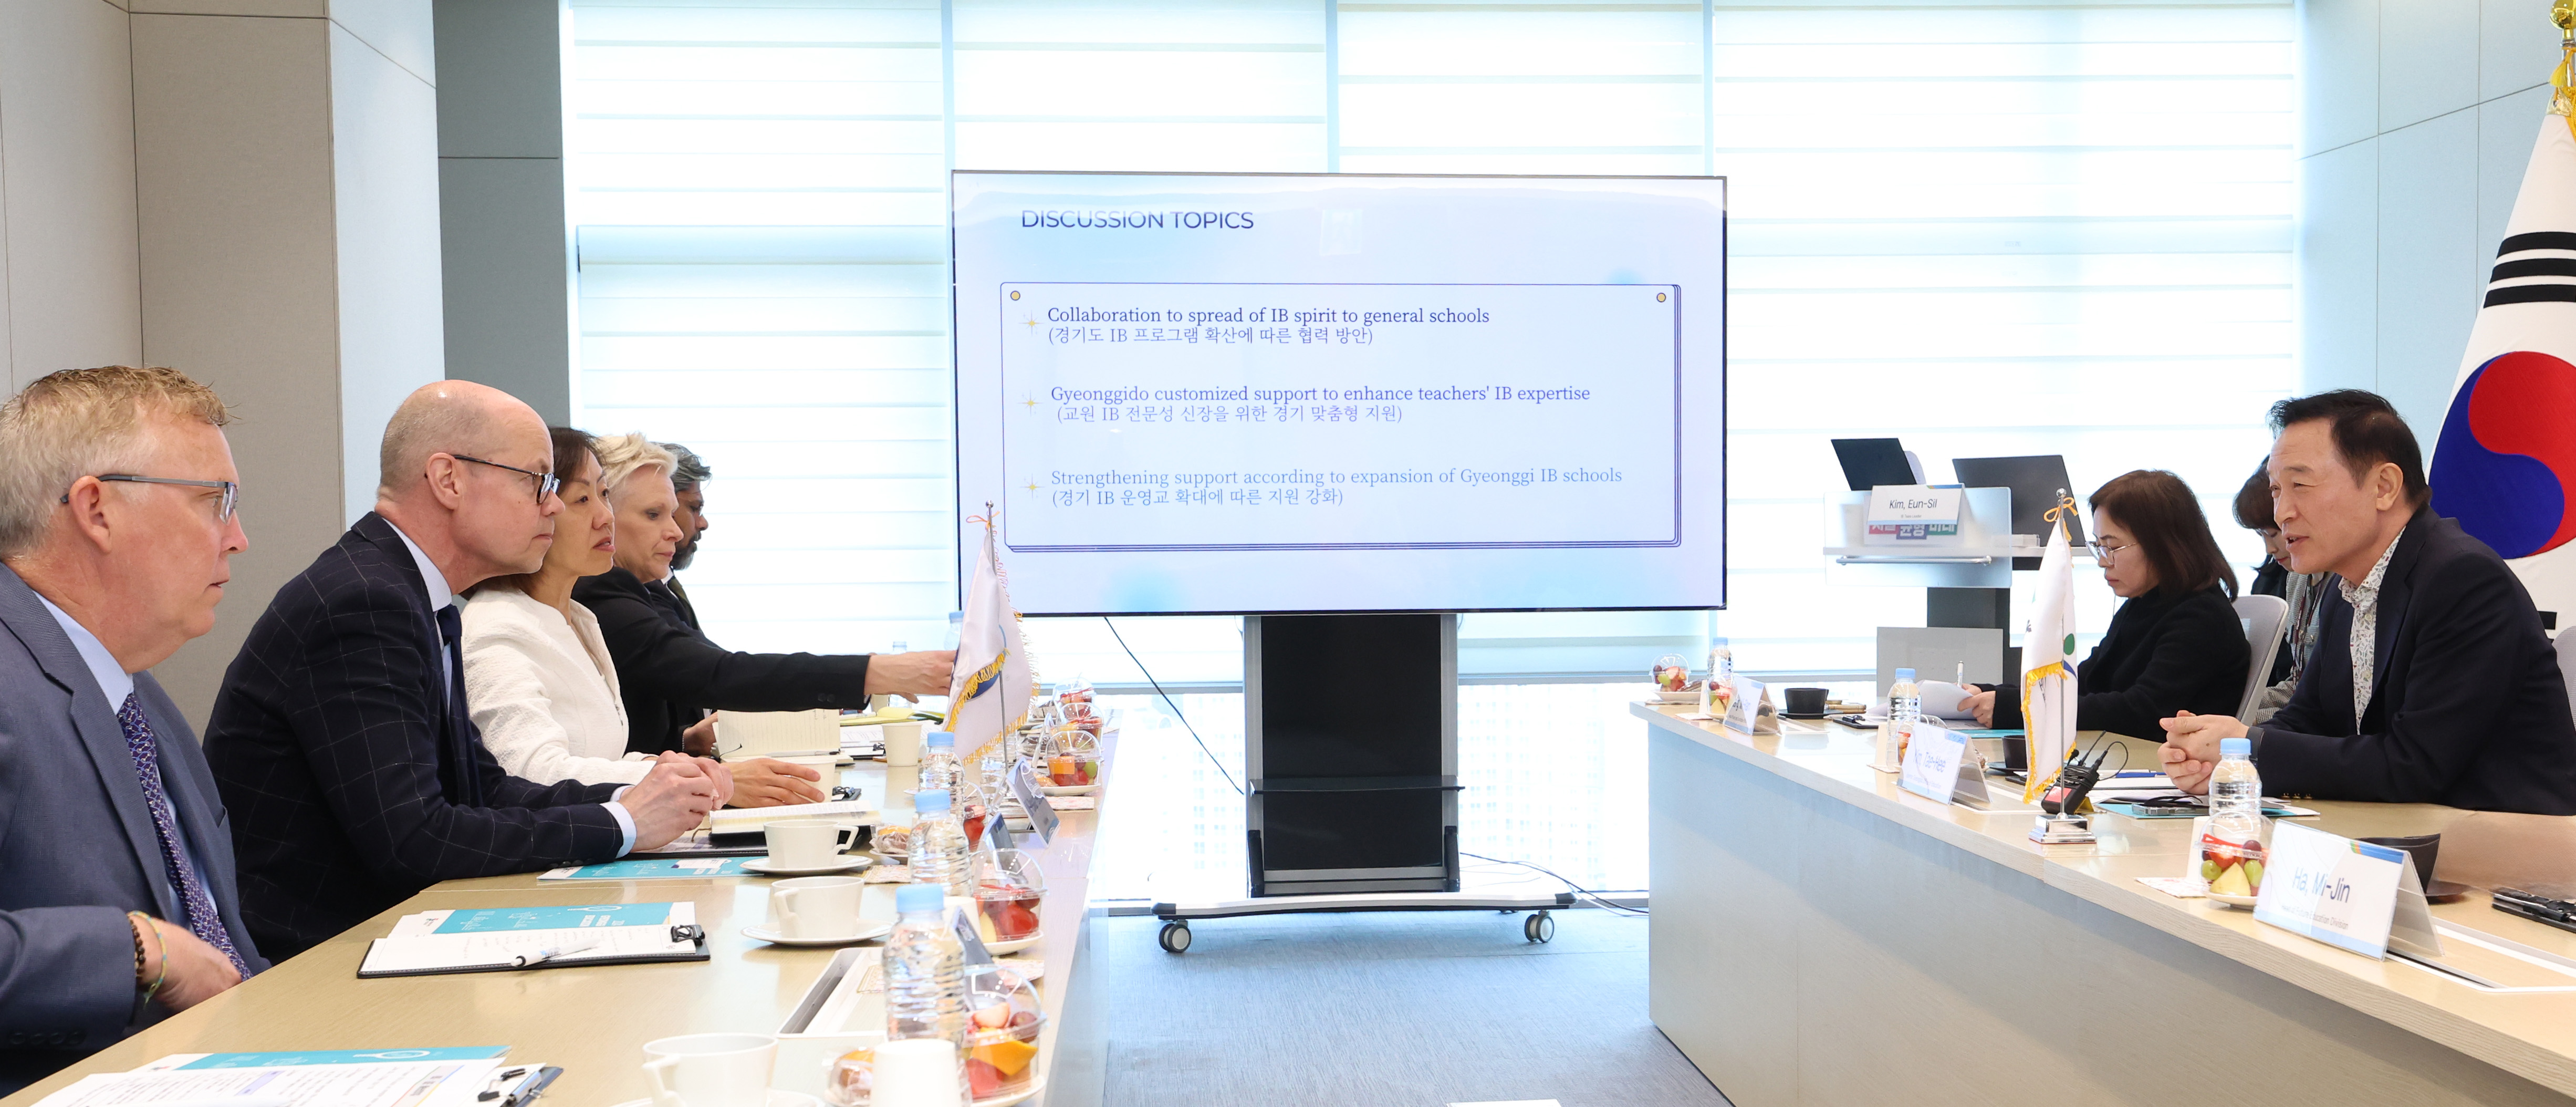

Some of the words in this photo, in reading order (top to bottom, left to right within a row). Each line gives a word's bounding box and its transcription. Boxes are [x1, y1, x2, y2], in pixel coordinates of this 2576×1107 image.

[1021, 209, 1164, 229] DISCUSSION
[1170, 211, 1255, 230] TOPICS
[1047, 306, 1162, 323] Collaboration
[1166, 308, 1183, 323] to
[1188, 307, 1244, 326] spread
[1249, 306, 1267, 323] of
[1271, 308, 1289, 323] IB
[1294, 307, 1338, 326] spirit
[1342, 309, 1358, 323] to
[1363, 307, 1424, 327] general
[1429, 307, 1490, 323] schools
[1049, 327, 1104, 346] (경기도
[1110, 328, 1128, 343] IB
[1133, 326, 1198, 344] 프로그램
[1204, 327, 1253, 344] 확산에
[1259, 327, 1292, 344] 따른
[1297, 326, 1328, 344] 협력
[1335, 326, 1373, 346] 방안)
[1051, 385, 1149, 407] Gyeonggido
[1154, 385, 1249, 401] customized
[1254, 387, 1318, 407] support
[1321, 387, 1339, 401] to
[1343, 385, 1413, 401] enhance
[1417, 385, 1489, 400] teachers'
[1494, 386, 1513, 400] IB
[1517, 385, 1591, 405] expertise
[1057, 405, 1096, 424] (교원
[1102, 407, 1120, 421] IB
[1125, 405, 1173, 422] 전문성
[1180, 405, 1229, 422] 신장을
[1235, 405, 1267, 422] 위한
[1273, 405, 1303, 422] 경기
[1310, 405, 1358, 422] 맞춤형
[1365, 405, 1402, 423] 지원)
[1051, 470, 1169, 488] Strengthening
[1174, 471, 1239, 489] support
[1243, 469, 1324, 488] according
[1329, 470, 1346, 484] to
[1350, 468, 1434, 487] expansion
[1438, 468, 1457, 483] of
[1460, 468, 1535, 486] Gyeonggi
[1540, 468, 1558, 483] IB
[1562, 467, 1622, 483] schools
[1052, 489, 1089, 508] (경기
[1096, 490, 1114, 505] IB
[1120, 489, 1170, 506] 운영교
[1174, 489, 1223, 506] 확대에
[1230, 489, 1263, 506] 따른
[1268, 489, 1299, 505] 지원
[1305, 488, 1343, 506] 강화)
[1889, 499, 1905, 510] Kim,
[1908, 499, 1937, 509] Eun-Sil
[2292, 866, 2308, 896] Ha,
[2312, 871, 2351, 903] Mi-Jin
[2330, 916, 2349, 930] Division
